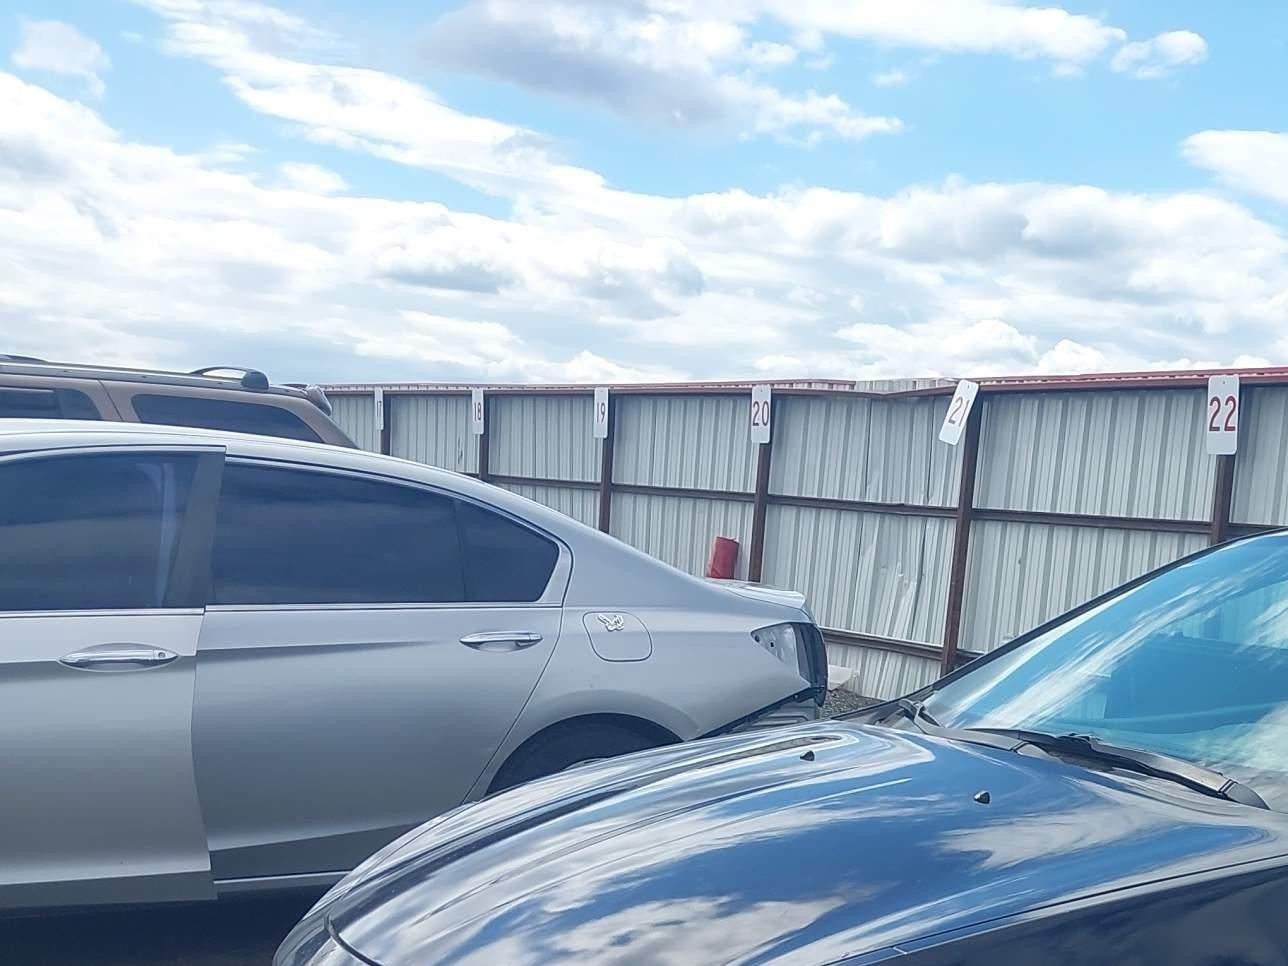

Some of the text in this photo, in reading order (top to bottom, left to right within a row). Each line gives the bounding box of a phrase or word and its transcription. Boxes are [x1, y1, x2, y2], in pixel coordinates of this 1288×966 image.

[474, 402, 482, 422] 18
[596, 402, 606, 424] 19
[752, 401, 770, 427] 20
[947, 396, 971, 427] 21
[1208, 396, 1237, 432] 22
